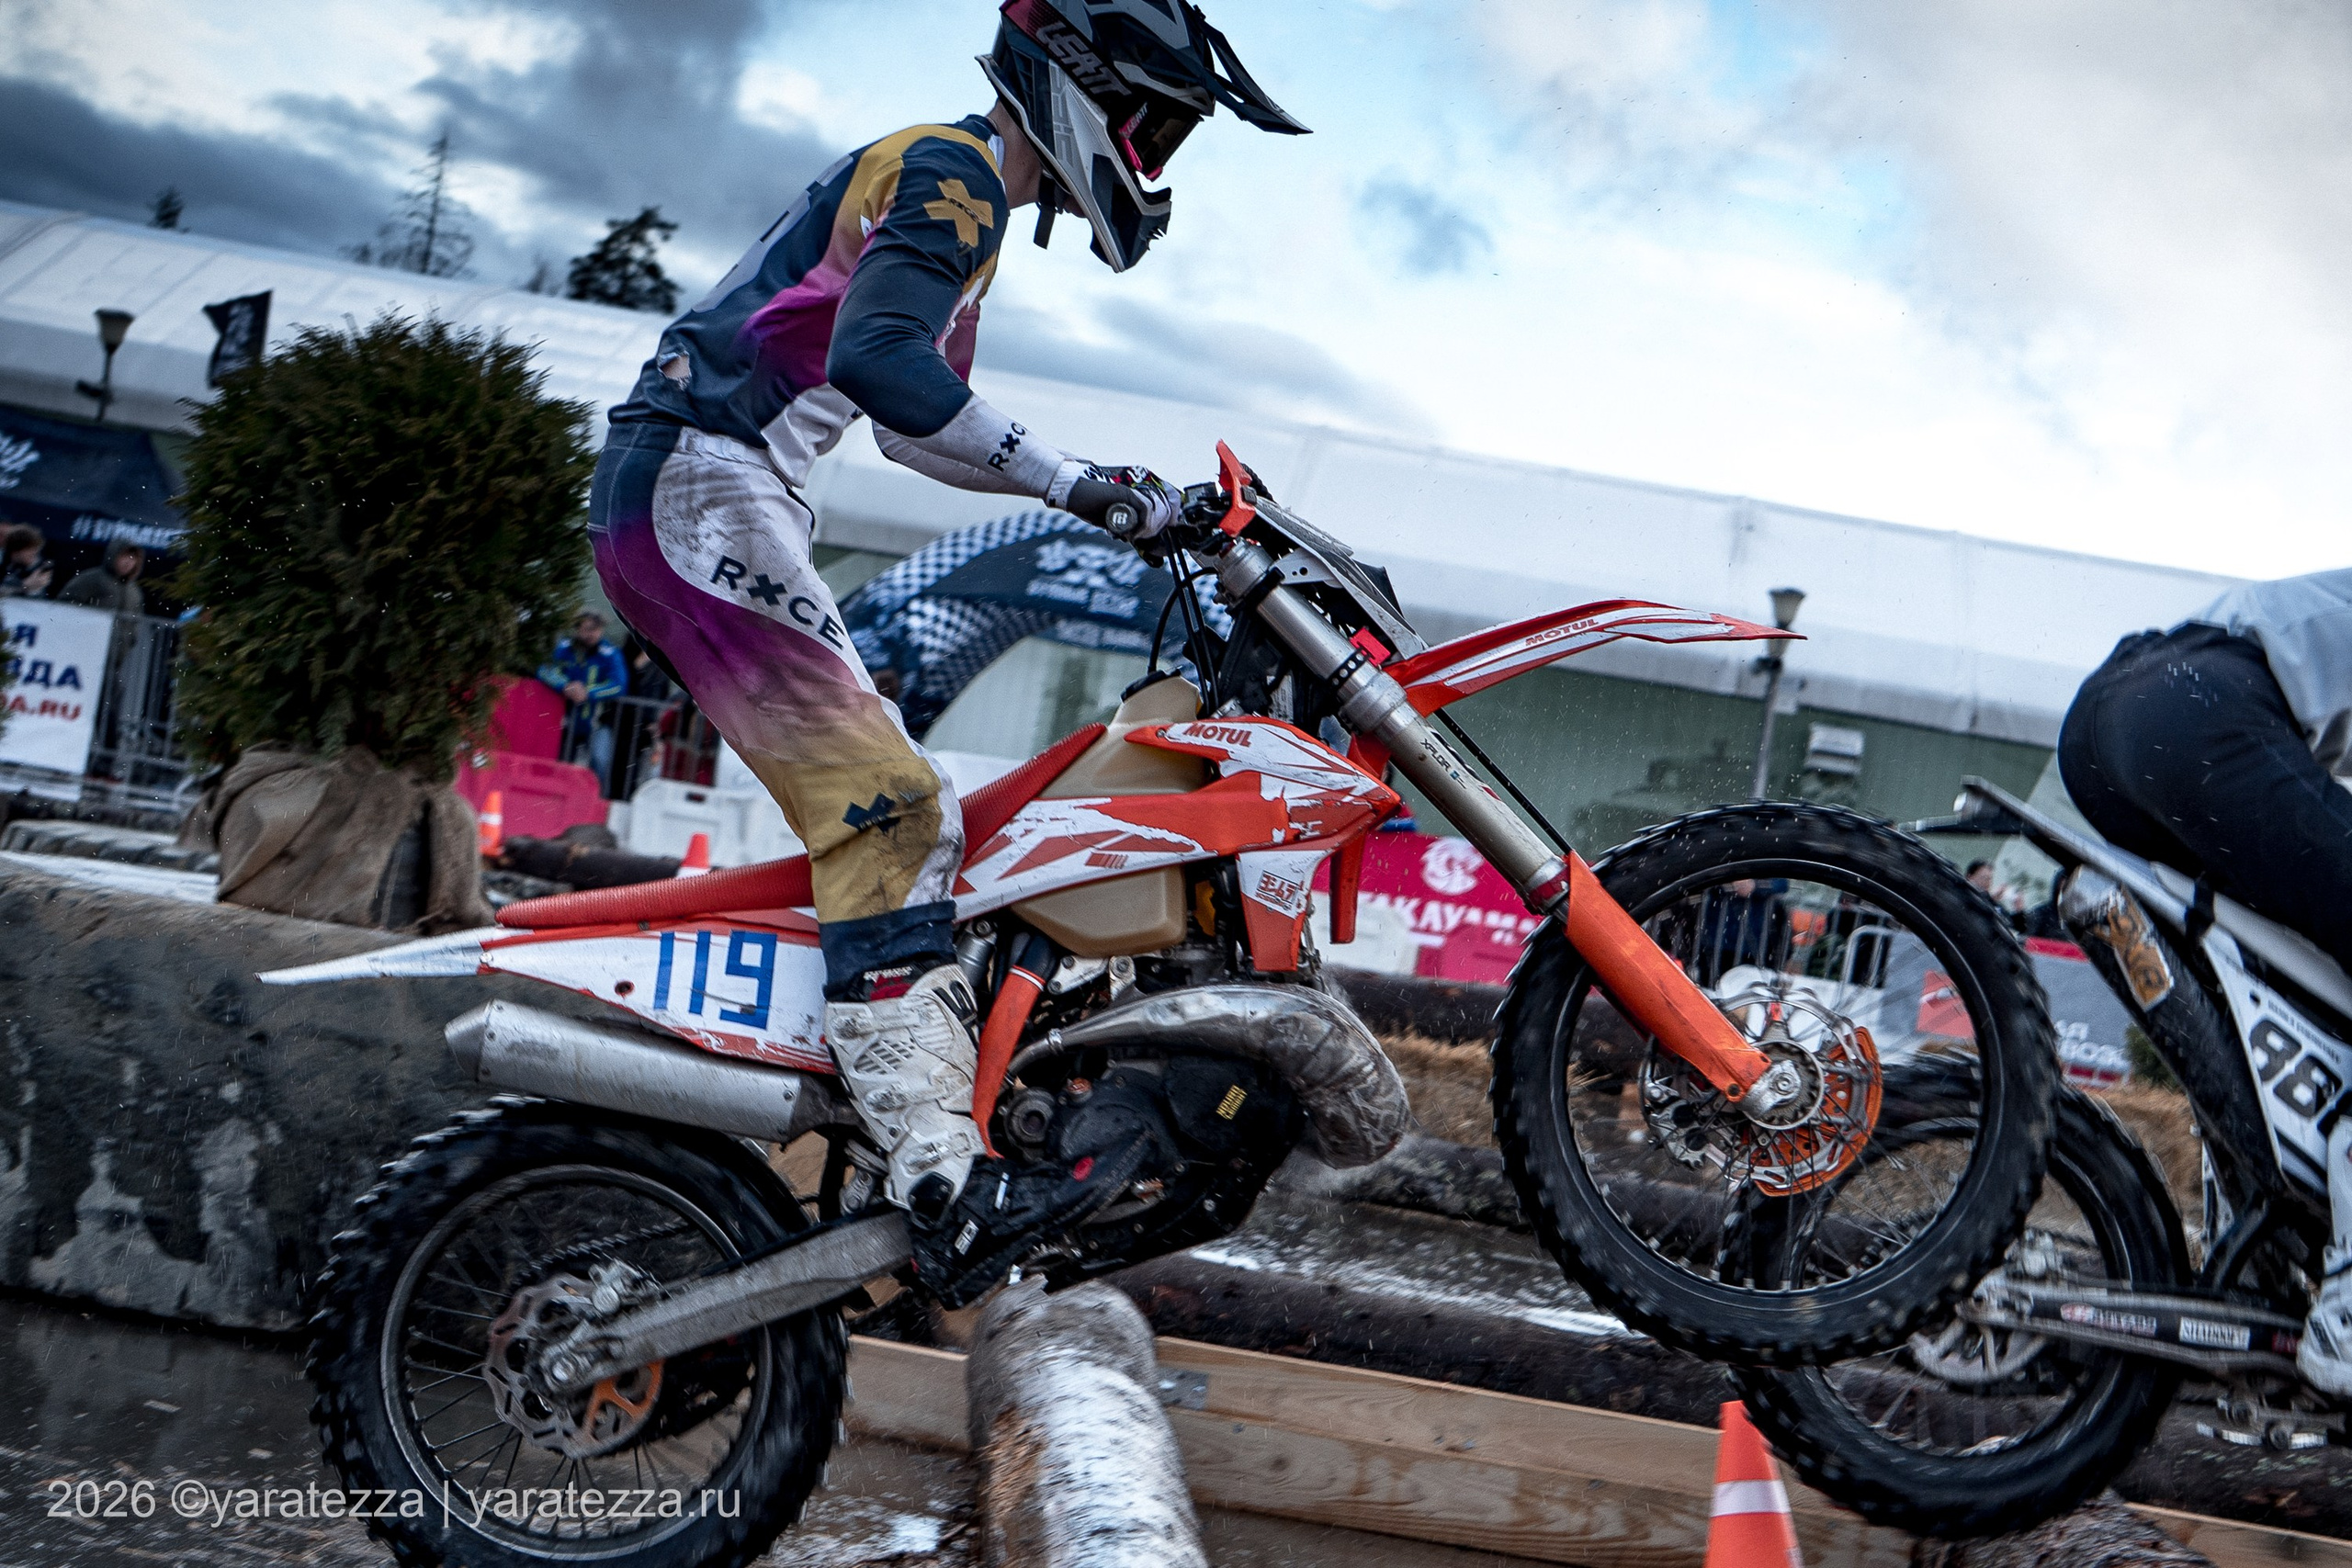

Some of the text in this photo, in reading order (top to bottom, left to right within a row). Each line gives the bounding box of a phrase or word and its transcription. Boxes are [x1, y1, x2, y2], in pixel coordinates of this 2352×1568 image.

[1035, 20, 1132, 96] LEATT
[988, 422, 1027, 473] RXC
[1525, 618, 1599, 646] MOTUL
[0, 693, 82, 721] A.RU
[1182, 722, 1252, 748] MOTUL
[653, 931, 778, 1030] 119
